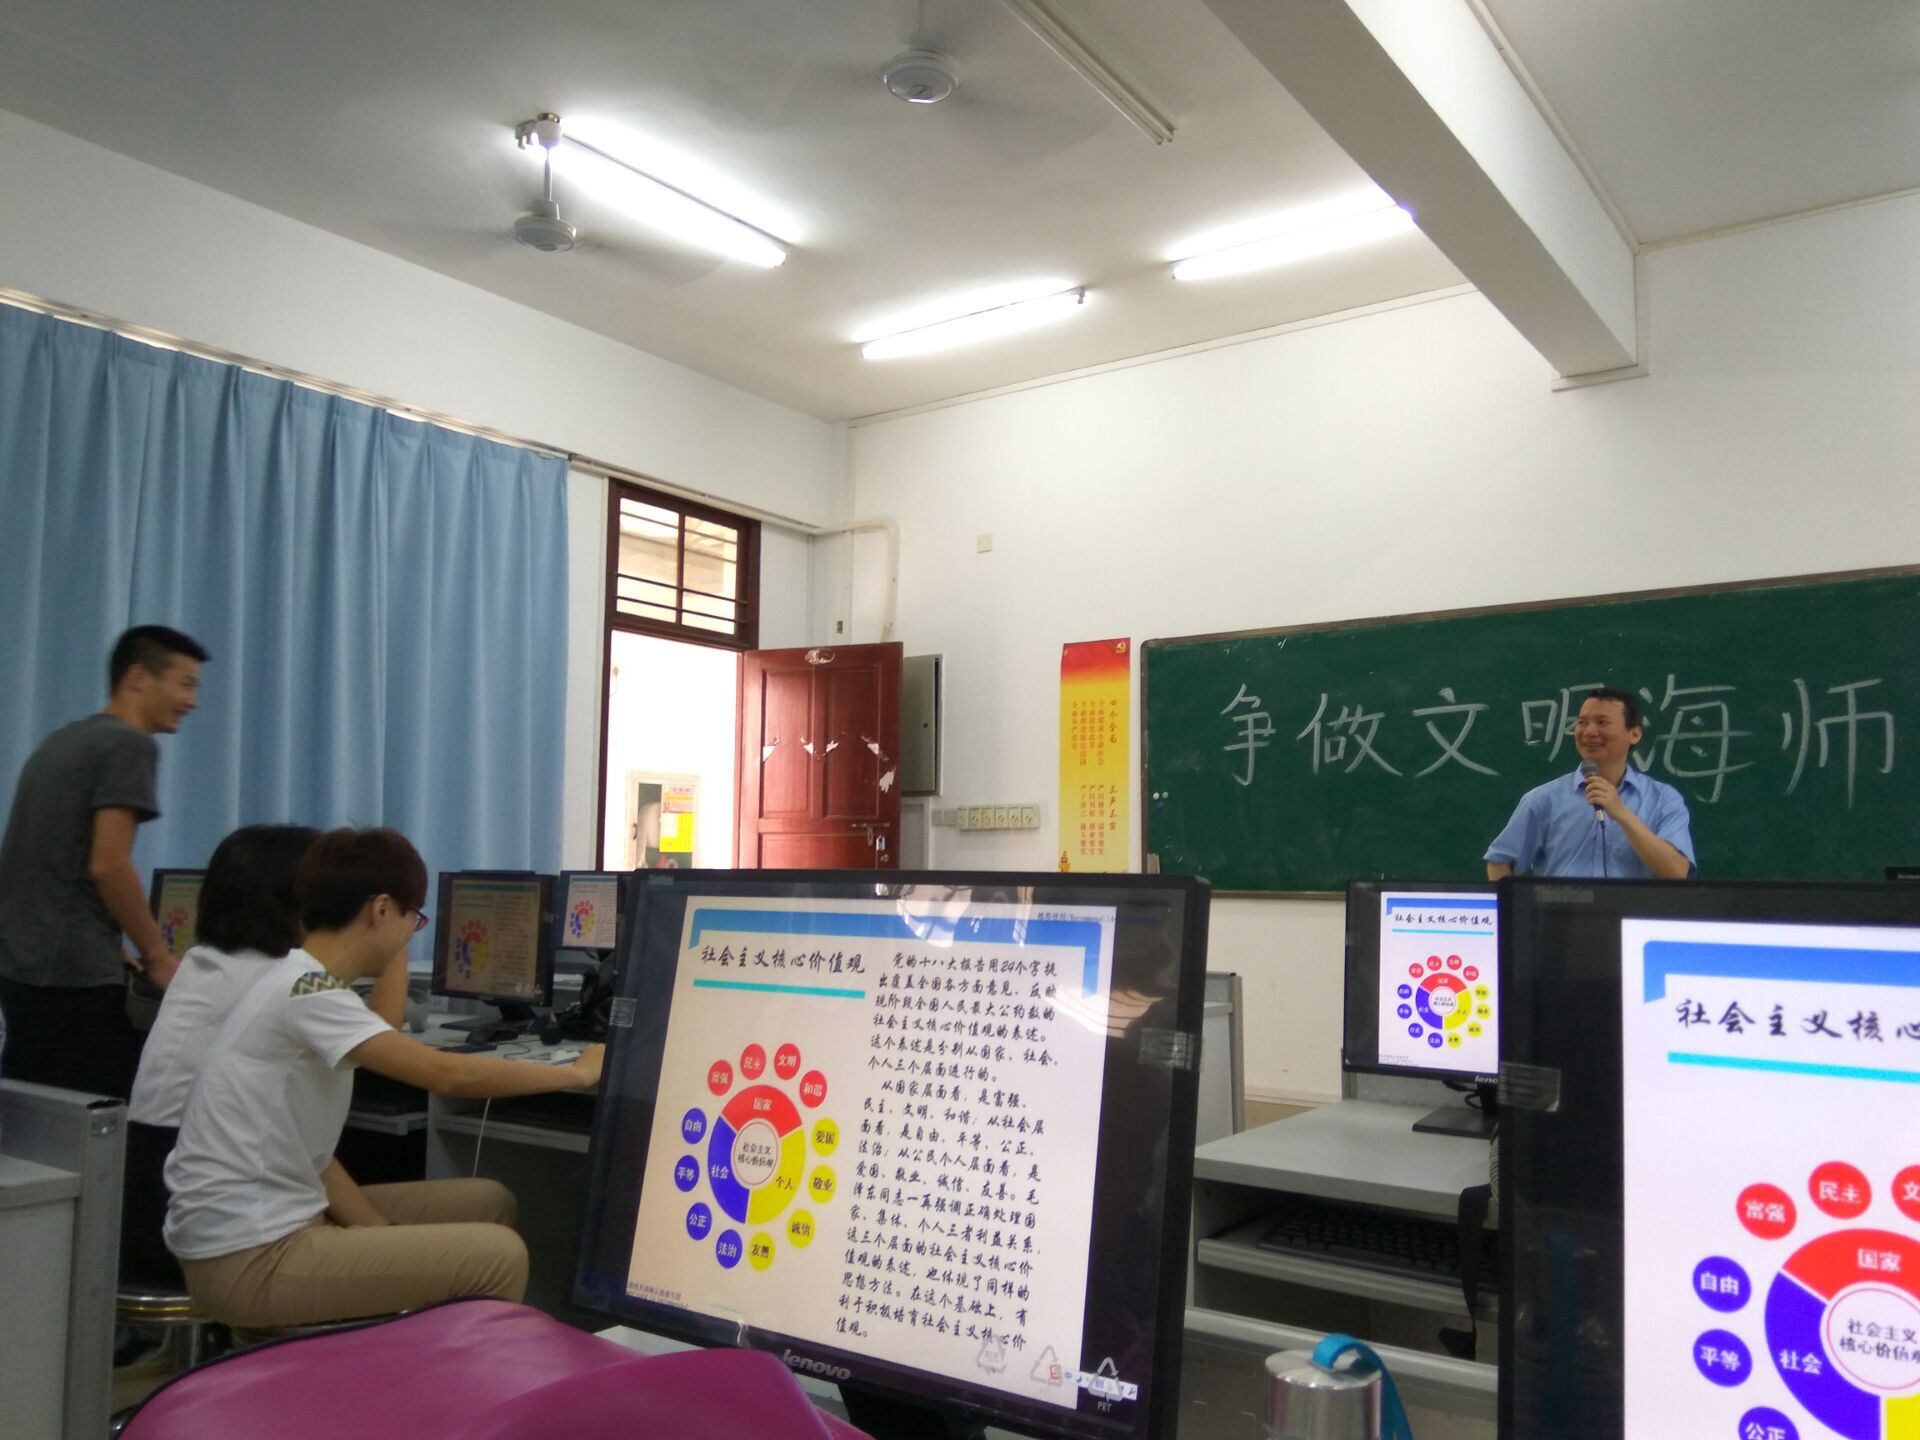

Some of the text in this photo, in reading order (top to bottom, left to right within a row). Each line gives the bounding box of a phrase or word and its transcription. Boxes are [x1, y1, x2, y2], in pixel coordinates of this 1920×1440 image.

[701, 945, 866, 974] 社会主义核心价值观
[892, 952, 1059, 977] 党的十八大报告用24个字提
[875, 993, 1056, 1021] 现阶段全国人民最大公约数的
[1675, 998, 1920, 1043] 社会主义核心
[778, 1055, 797, 1068] 文明
[803, 1083, 823, 1096] 和谐
[753, 1098, 773, 1112] 国家
[684, 1119, 702, 1133] 自由
[816, 1130, 835, 1144] 爱国
[676, 1167, 695, 1182] 平等
[711, 1164, 729, 1180] 社会
[776, 1176, 794, 1190] 个人
[813, 1177, 833, 1192] 敬业
[1819, 1180, 1861, 1204] 民主
[852, 1181, 1037, 1229] 泽东同志一再强调正确处理国
[1744, 1199, 1786, 1223] 富强
[689, 1213, 707, 1228] 公正
[791, 1223, 811, 1237] 诚信
[718, 1242, 737, 1257] 法治
[846, 1226, 1033, 1277] 这三个层面的社会主义核心价
[1857, 1247, 1902, 1272] 国家
[1700, 1271, 1740, 1296] 自由
[838, 1293, 1027, 1352] 利于积极培育社会主义核心价
[1847, 1318, 1918, 1345] 社会主义
[783, 1349, 851, 1381] lenovo
[1700, 1345, 1741, 1372] 平等
[1779, 1348, 1823, 1375] 社会
